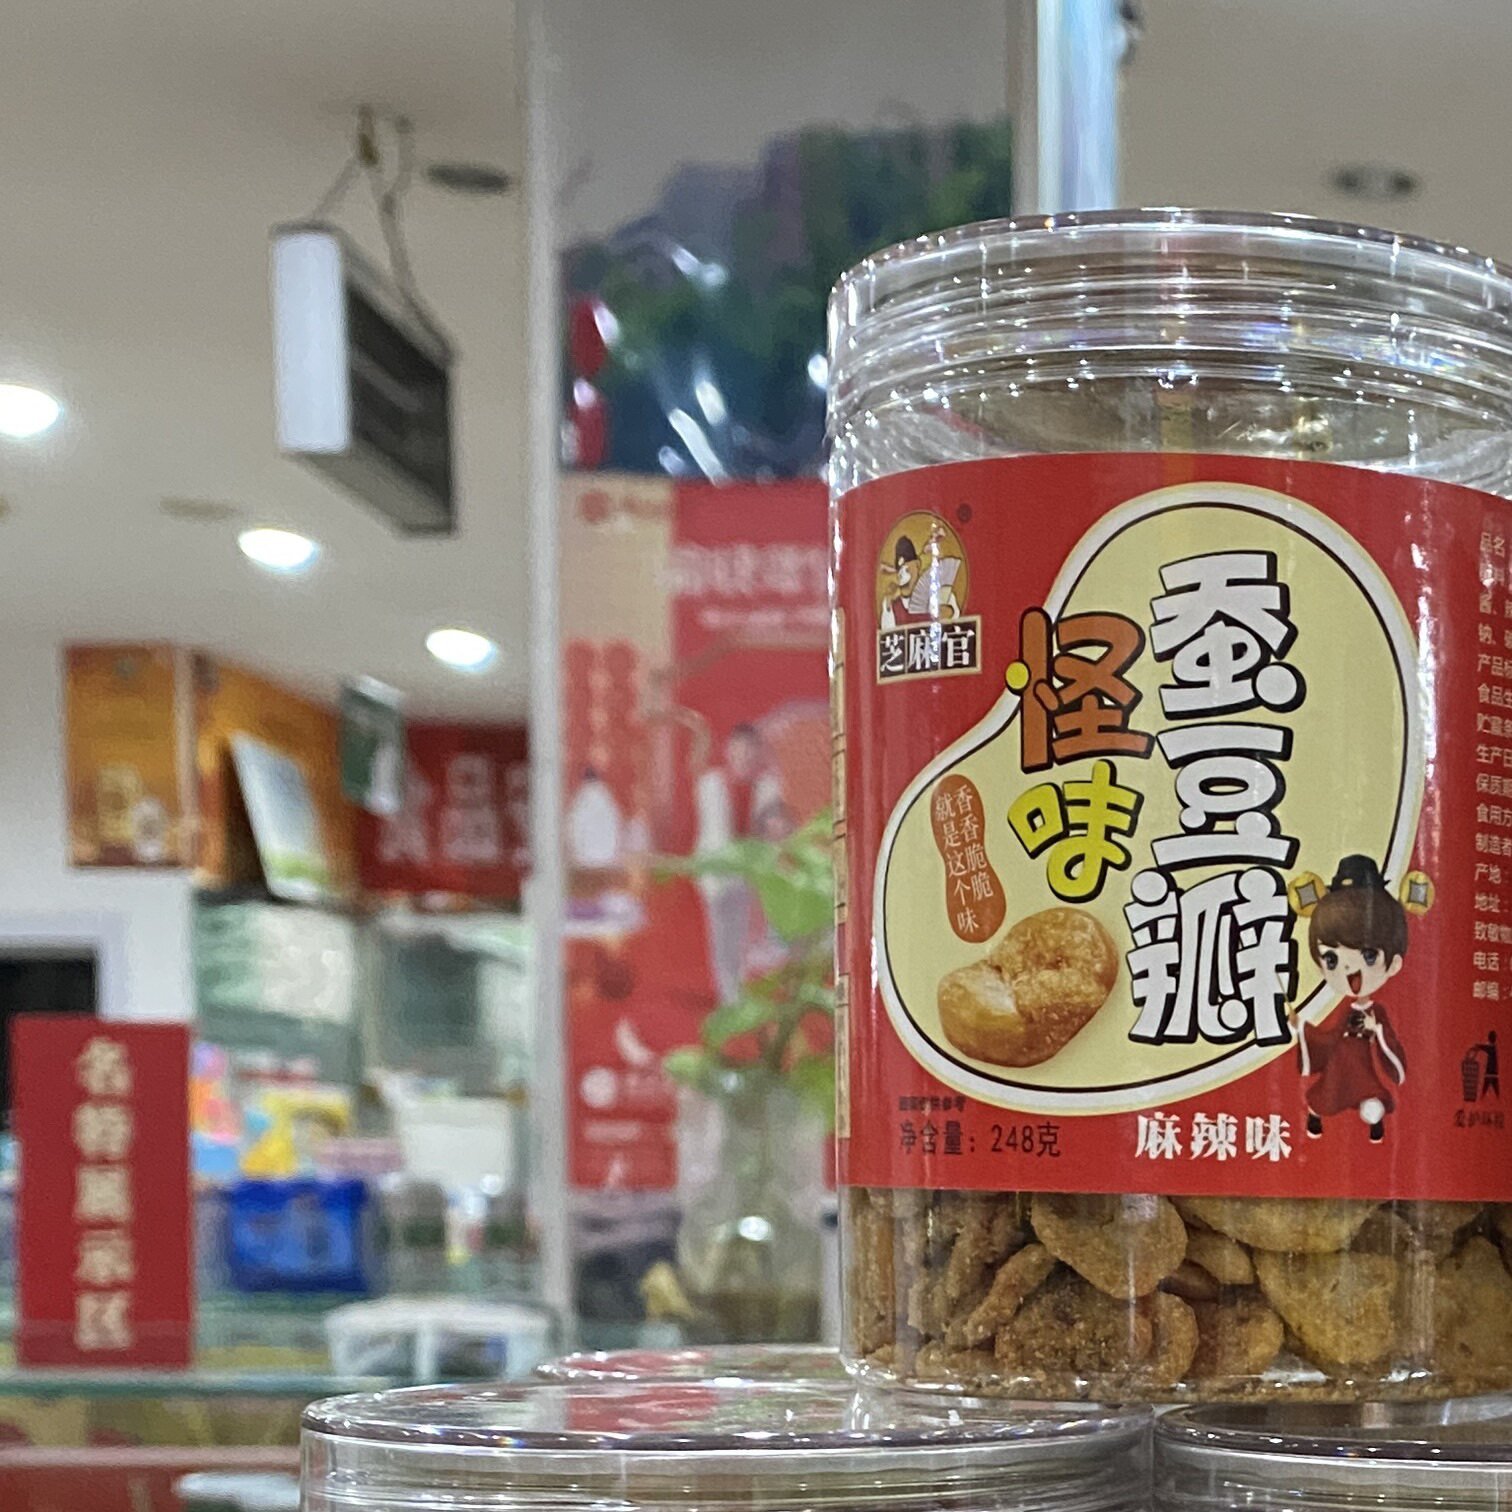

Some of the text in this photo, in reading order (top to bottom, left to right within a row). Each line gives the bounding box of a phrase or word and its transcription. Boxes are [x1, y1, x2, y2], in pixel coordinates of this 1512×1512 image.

[880, 626, 975, 671] 芝麻官
[954, 784, 994, 900] 香香脆脆
[1124, 551, 1306, 1045] 蚕豆瓣
[935, 794, 980, 934] 就是这个味
[1134, 1112, 1293, 1162] 麻辣味
